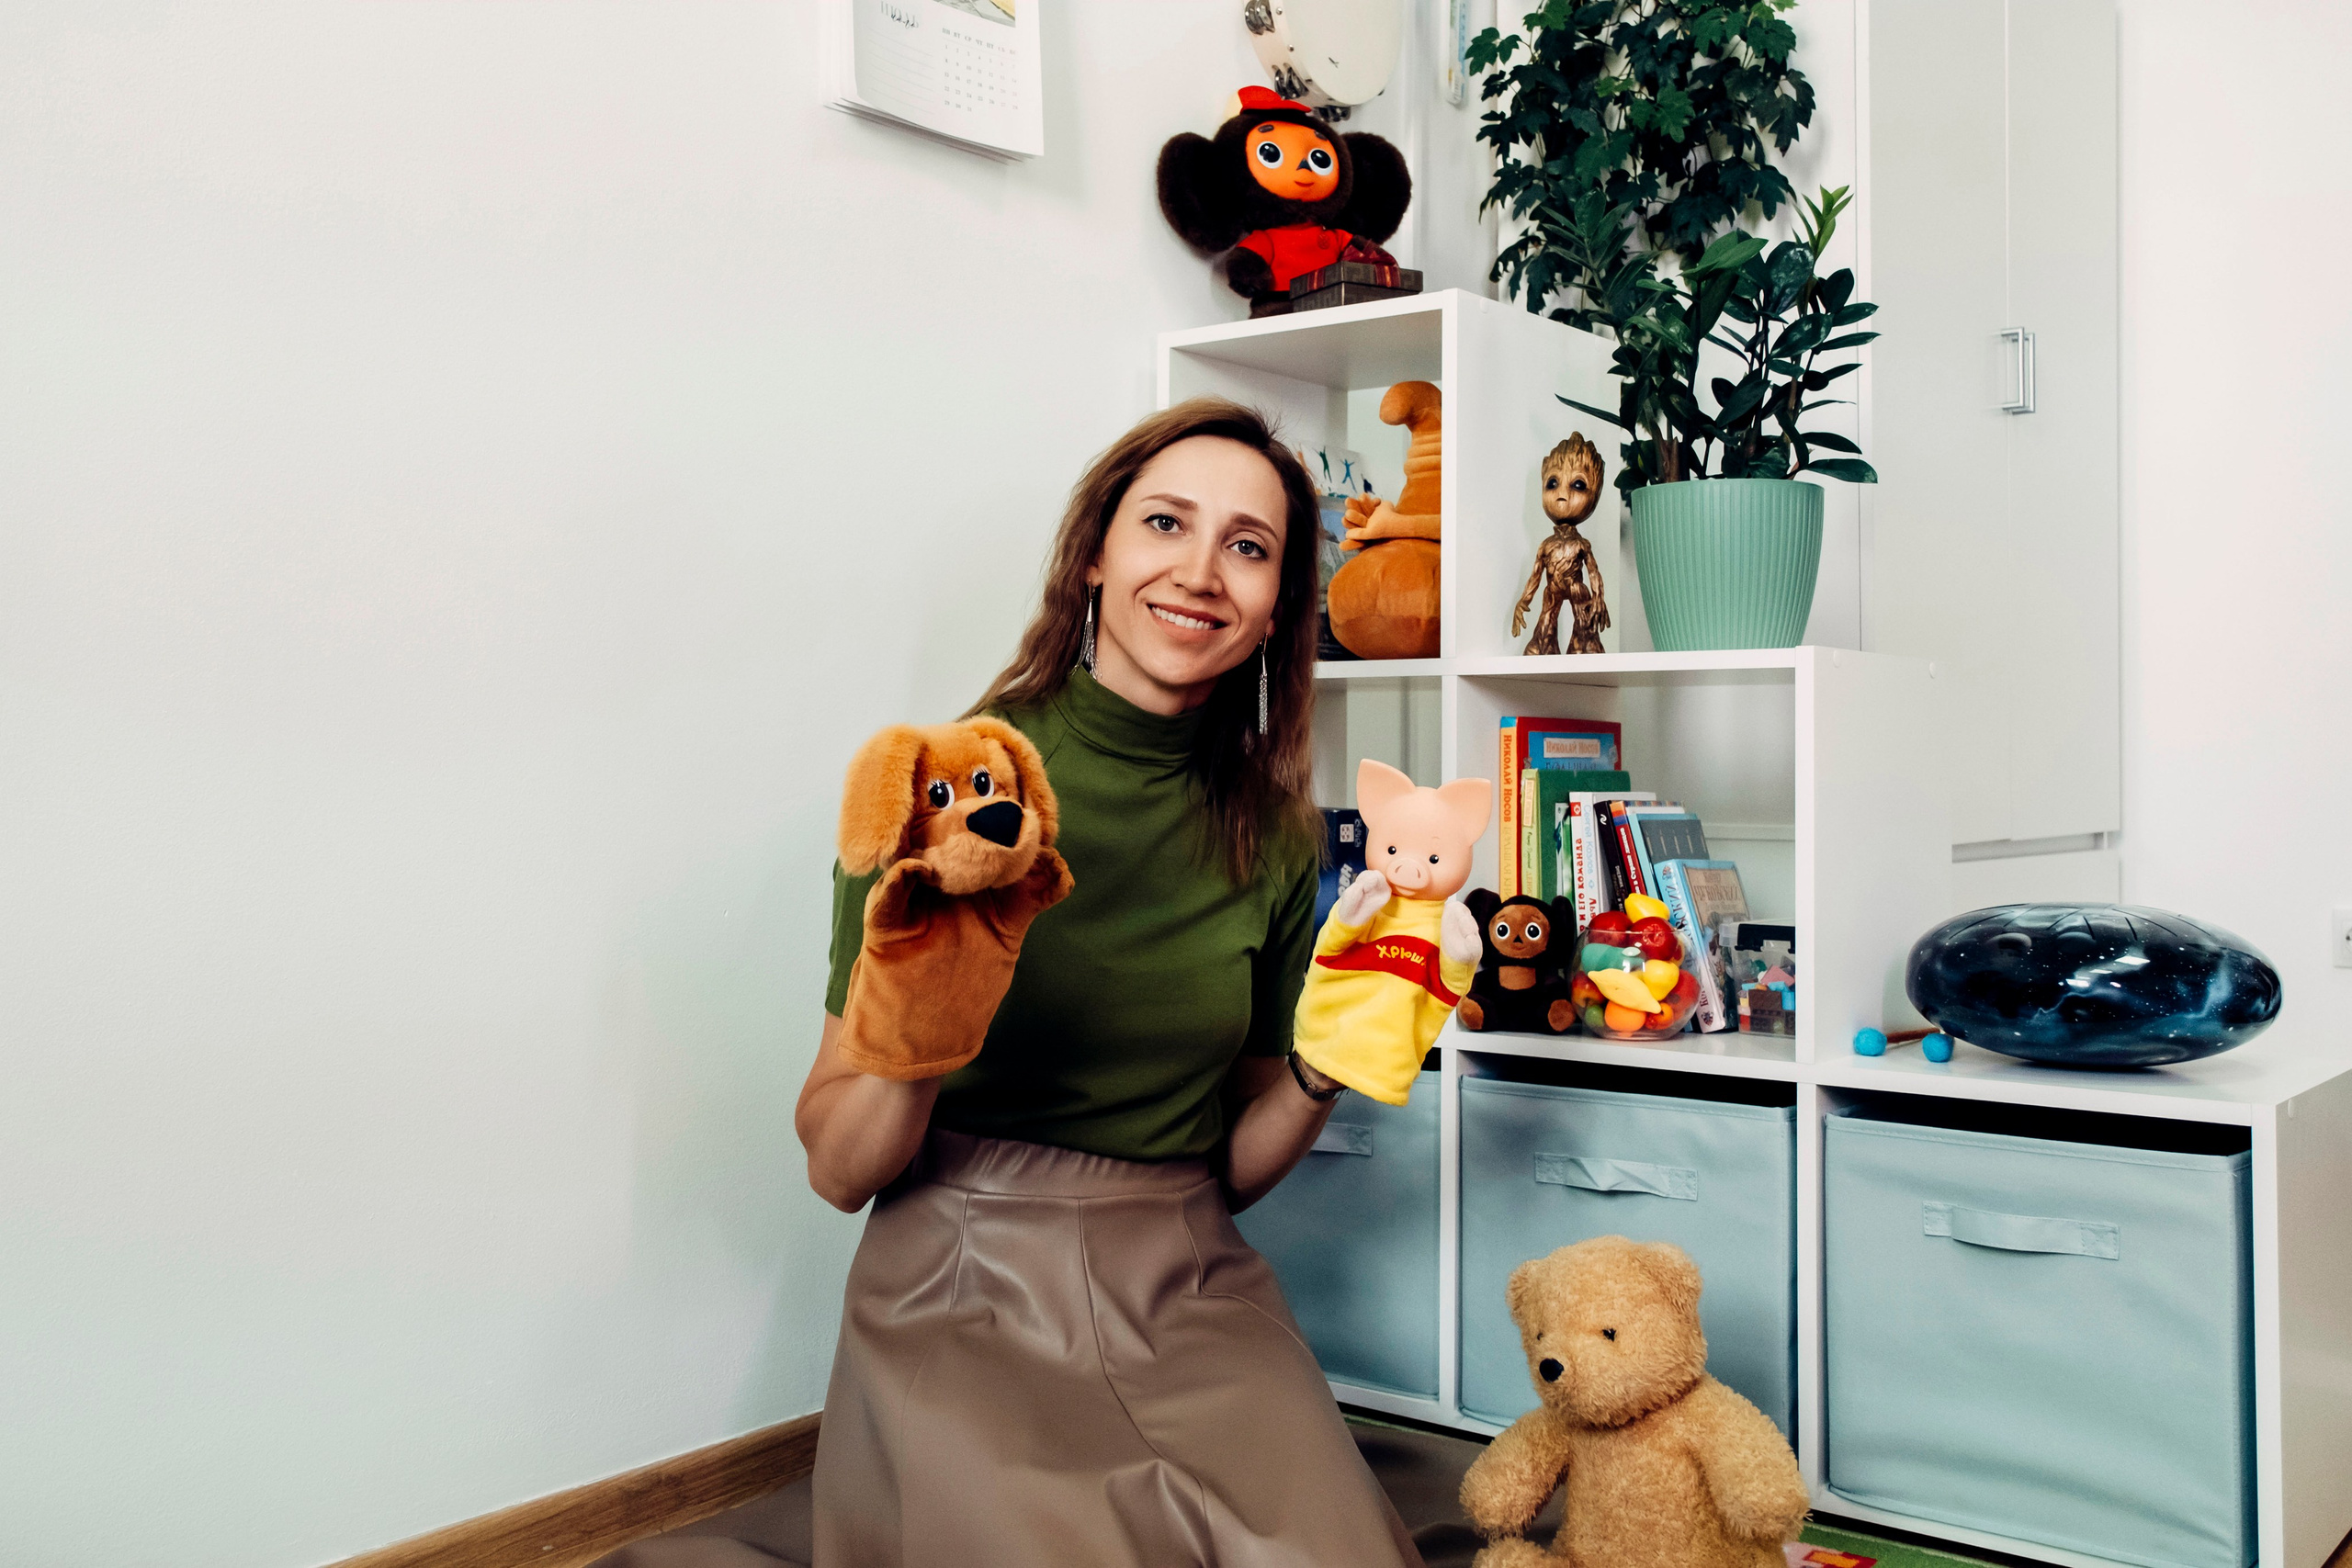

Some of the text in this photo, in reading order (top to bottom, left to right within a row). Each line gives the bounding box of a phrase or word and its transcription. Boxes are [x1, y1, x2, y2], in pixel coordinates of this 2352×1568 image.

[1502, 735, 1513, 785] НИКОЛАЙ
[1546, 740, 1577, 754] НИКОЛАЙ
[1503, 788, 1513, 823] НОСОВ
[1583, 805, 1592, 837] Сергей
[1585, 840, 1594, 874] Козлов
[1502, 876, 1512, 900] КНИ
